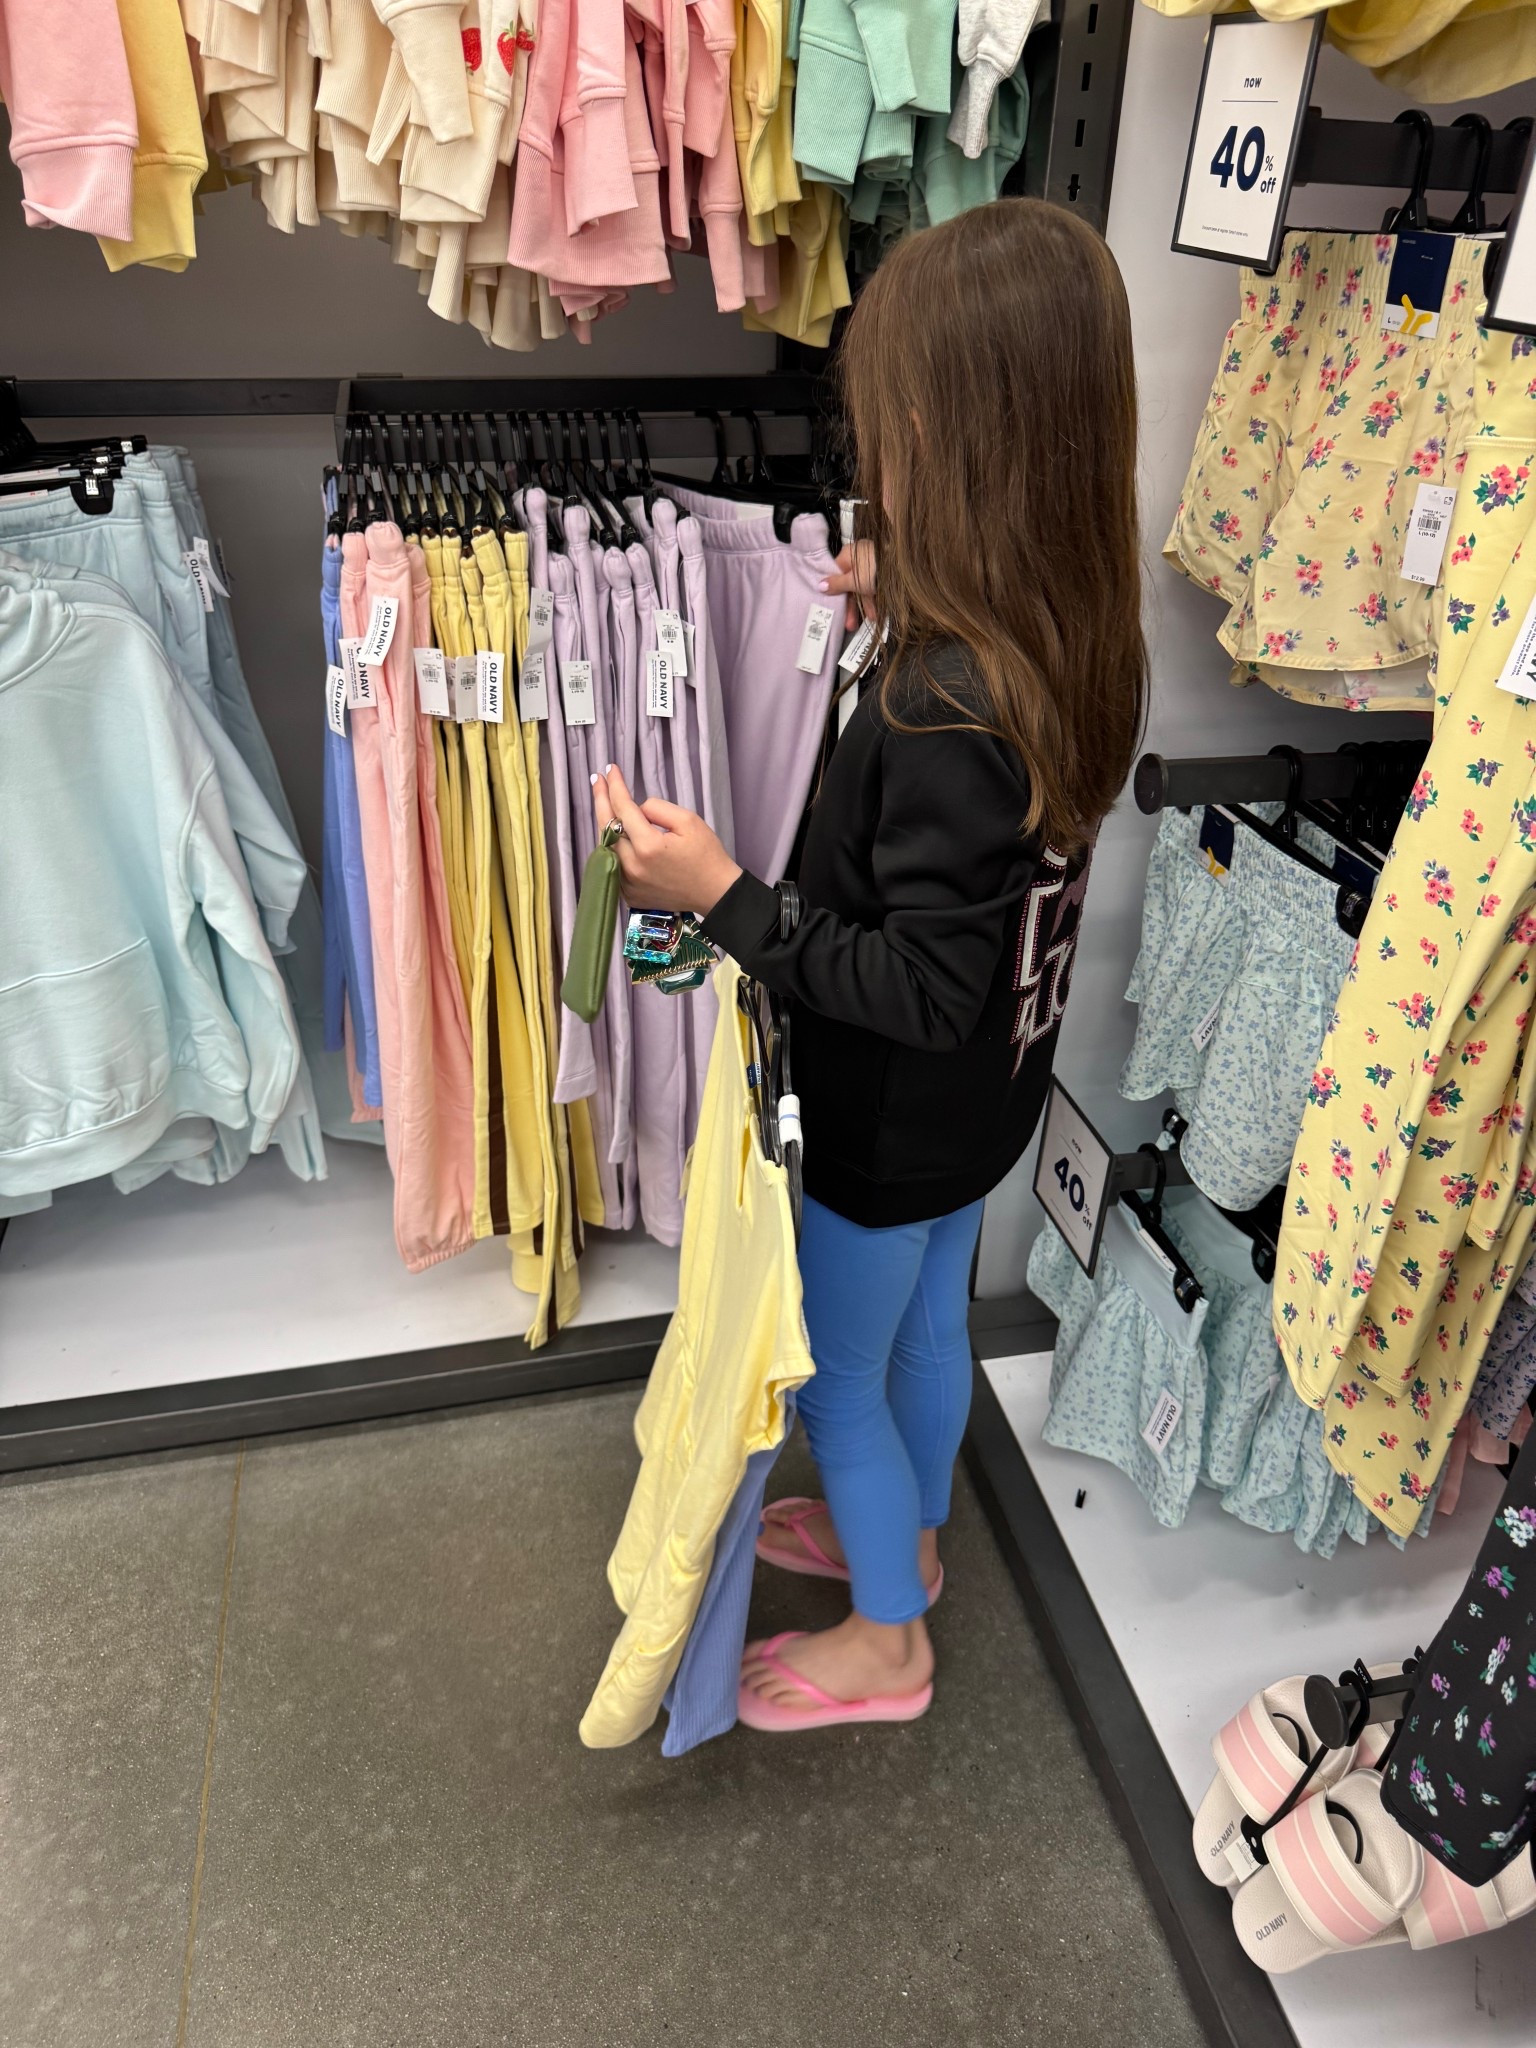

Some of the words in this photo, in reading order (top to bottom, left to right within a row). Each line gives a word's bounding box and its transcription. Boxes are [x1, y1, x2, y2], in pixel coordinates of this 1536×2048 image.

[1244, 76, 1262, 88] now
[1260, 177, 1276, 194] off
[190, 559, 200, 577] OLD
[382, 607, 392, 628] OLD
[373, 630, 388, 657] NAVY
[489, 662, 497, 683] OLD
[659, 660, 667, 680] OLD
[335, 678, 344, 699] OLD
[359, 670, 370, 699] NAVY
[659, 681, 668, 709] NAVY
[489, 685, 498, 714] NAVY
[334, 699, 342, 728] NAVY
[1071, 1138, 1082, 1154] now
[1054, 1156, 1085, 1212] 40
[1082, 1216, 1093, 1231] off
[1167, 1404, 1177, 1422] OLD
[1156, 1420, 1170, 1444] NAVY
[1211, 1839, 1223, 1857] OLD
[1222, 1820, 1235, 1844] NAVY
[1255, 1925, 1271, 1941] OLD
[1270, 1912, 1288, 1932] NAVY
